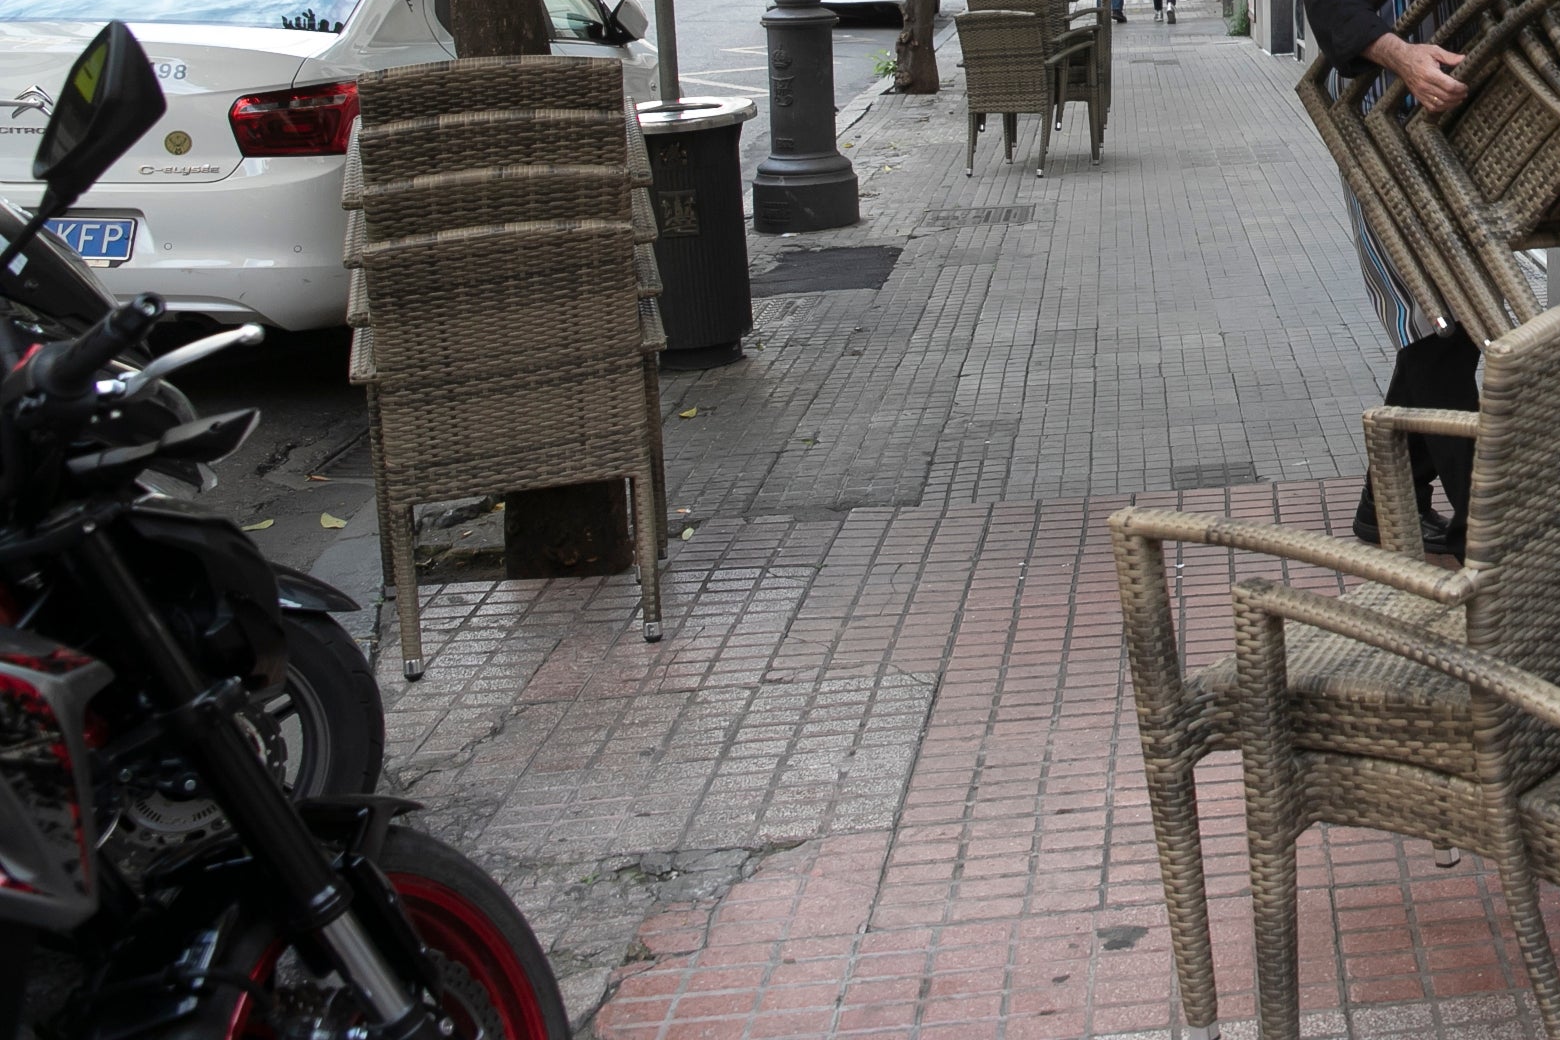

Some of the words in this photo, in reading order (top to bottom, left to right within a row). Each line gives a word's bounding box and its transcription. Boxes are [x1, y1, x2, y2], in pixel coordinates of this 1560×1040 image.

[150, 62, 187, 80] 98
[0, 126, 47, 135] CITRO
[57, 223, 124, 254] KFP
